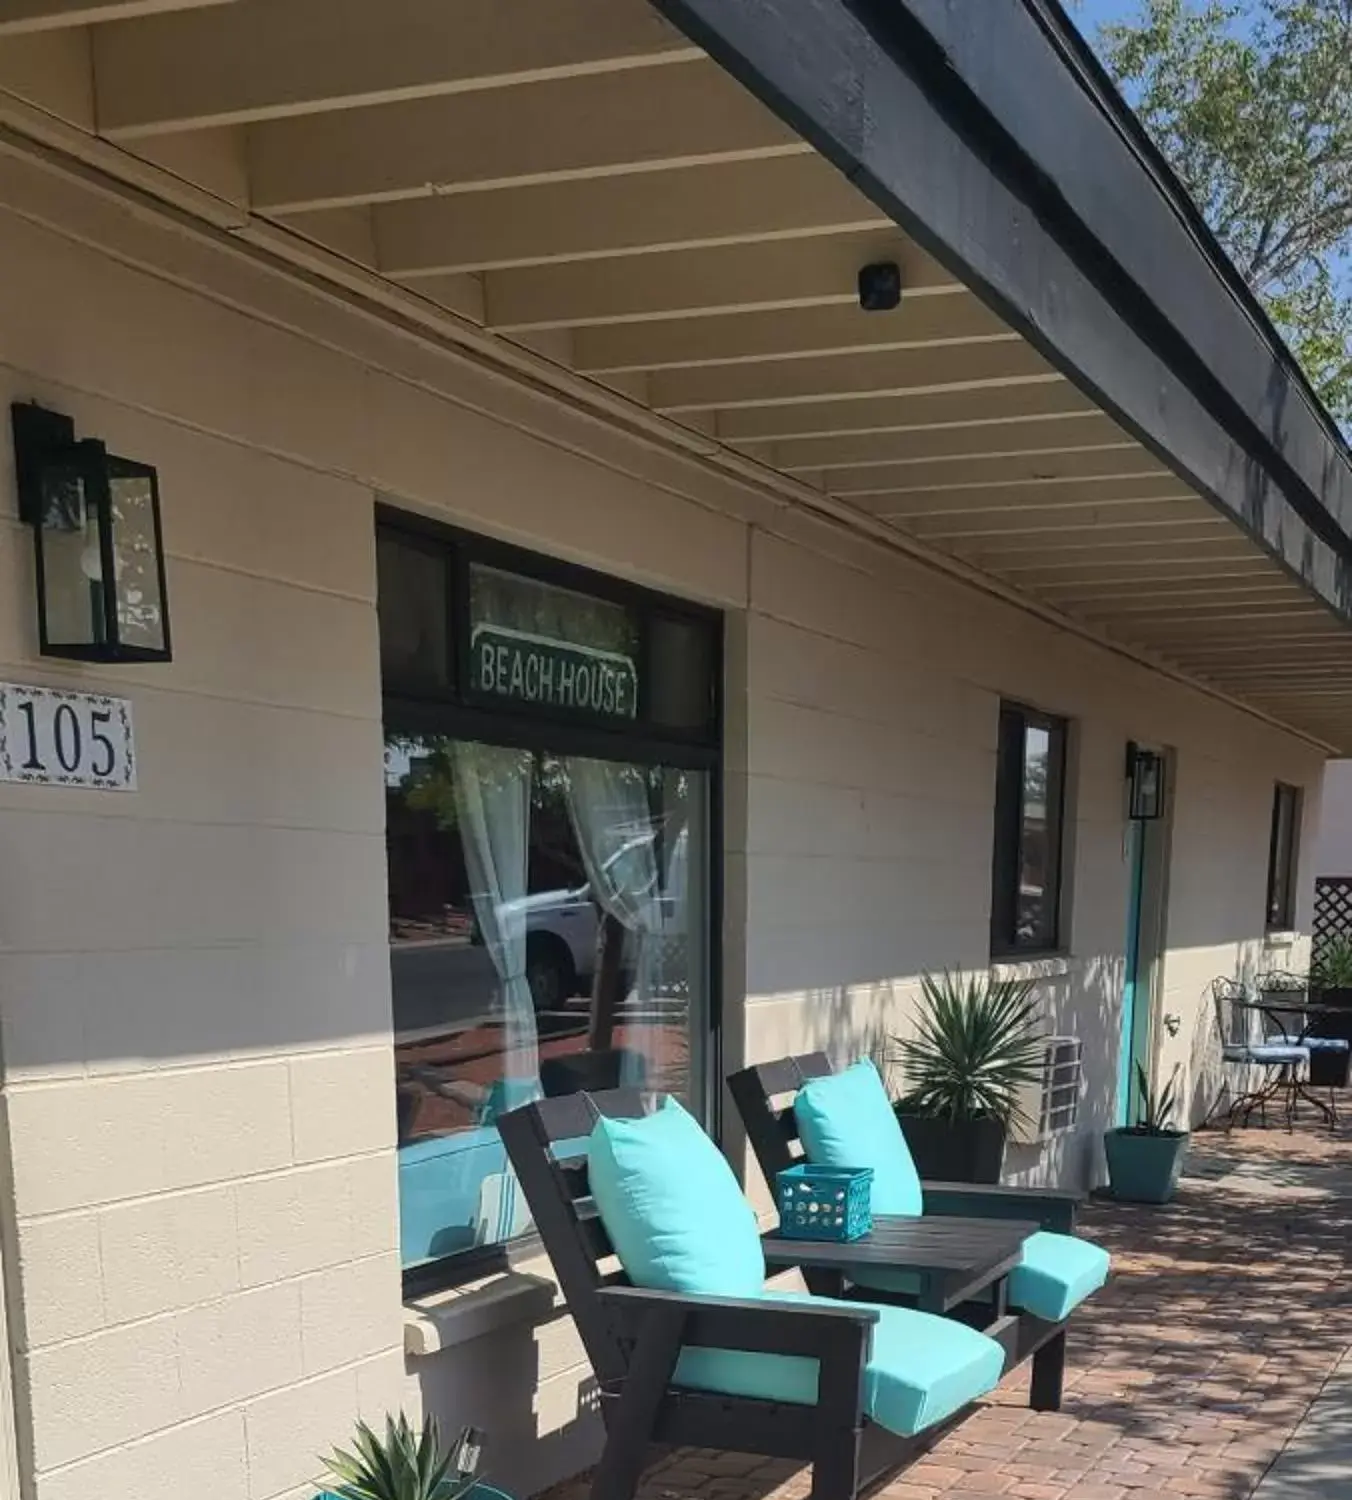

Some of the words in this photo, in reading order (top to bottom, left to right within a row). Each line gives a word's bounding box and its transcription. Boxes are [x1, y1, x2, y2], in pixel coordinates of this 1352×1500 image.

[480, 642, 553, 701] BEACH
[558, 661, 627, 715] HOUSE
[18, 701, 115, 777] 105
